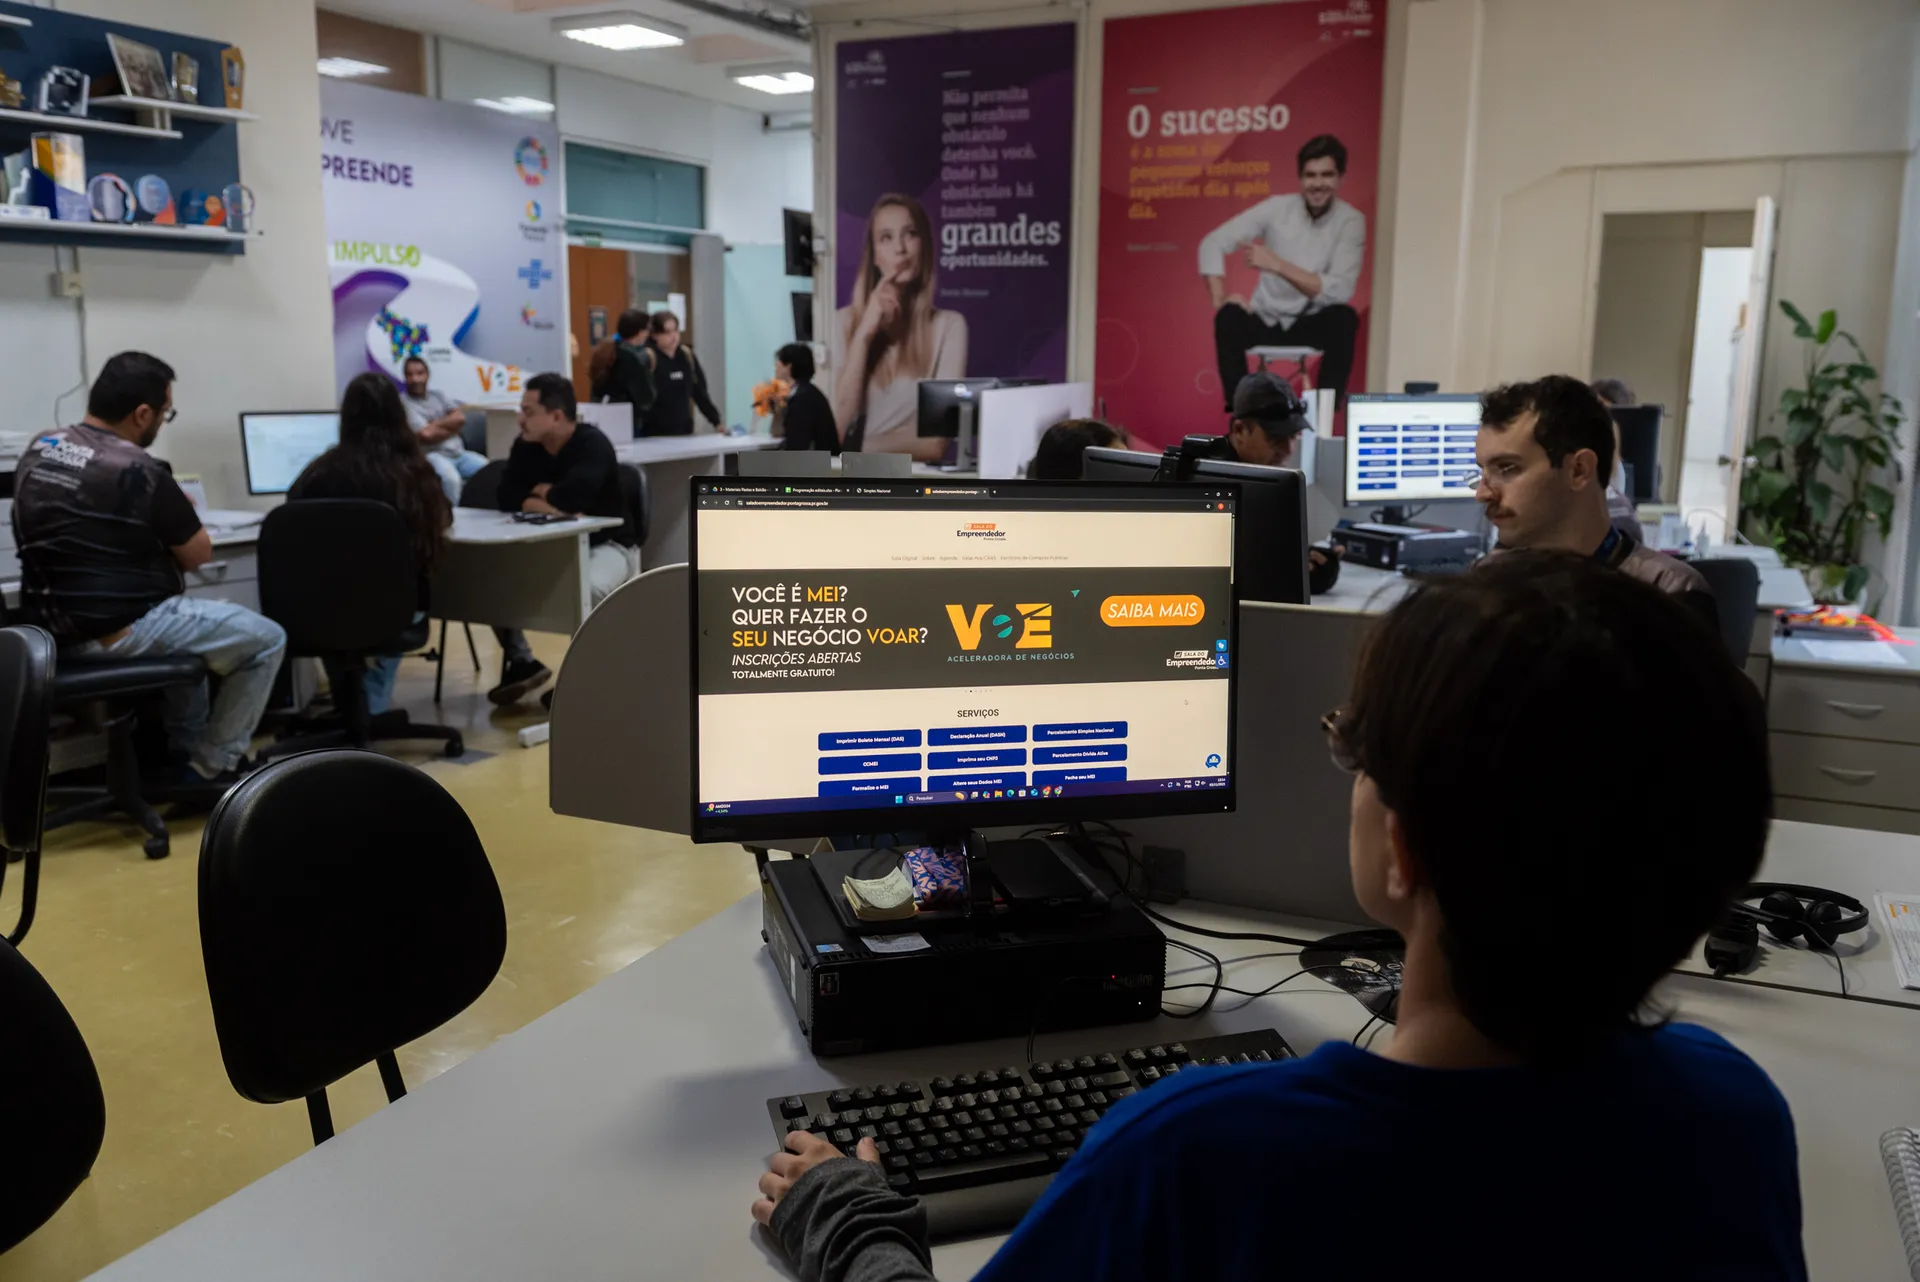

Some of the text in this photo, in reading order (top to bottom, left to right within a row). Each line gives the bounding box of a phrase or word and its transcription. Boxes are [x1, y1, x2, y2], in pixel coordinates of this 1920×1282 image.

[1127, 103, 1291, 138] O sucesso
[940, 212, 1062, 255] grandes
[940, 249, 1050, 272] oportunidades.
[956, 529, 1007, 539] Empreendedor
[731, 582, 848, 603] VOCÊ É MEI?
[731, 607, 868, 626] QUER FAZER O
[1107, 601, 1199, 619] SAIBA MAIS
[731, 625, 929, 648] SEU NEGÓCIO VOAR?
[731, 650, 862, 669] INSCRIÇÕES ABERTAS
[947, 651, 1075, 663] ACELERADORA DE NEGÓCIOS
[1166, 657, 1216, 669] Empreendedo
[731, 668, 836, 679] TOTALMENTE GRATUITO!
[957, 708, 1000, 719] SERVIÇOS
